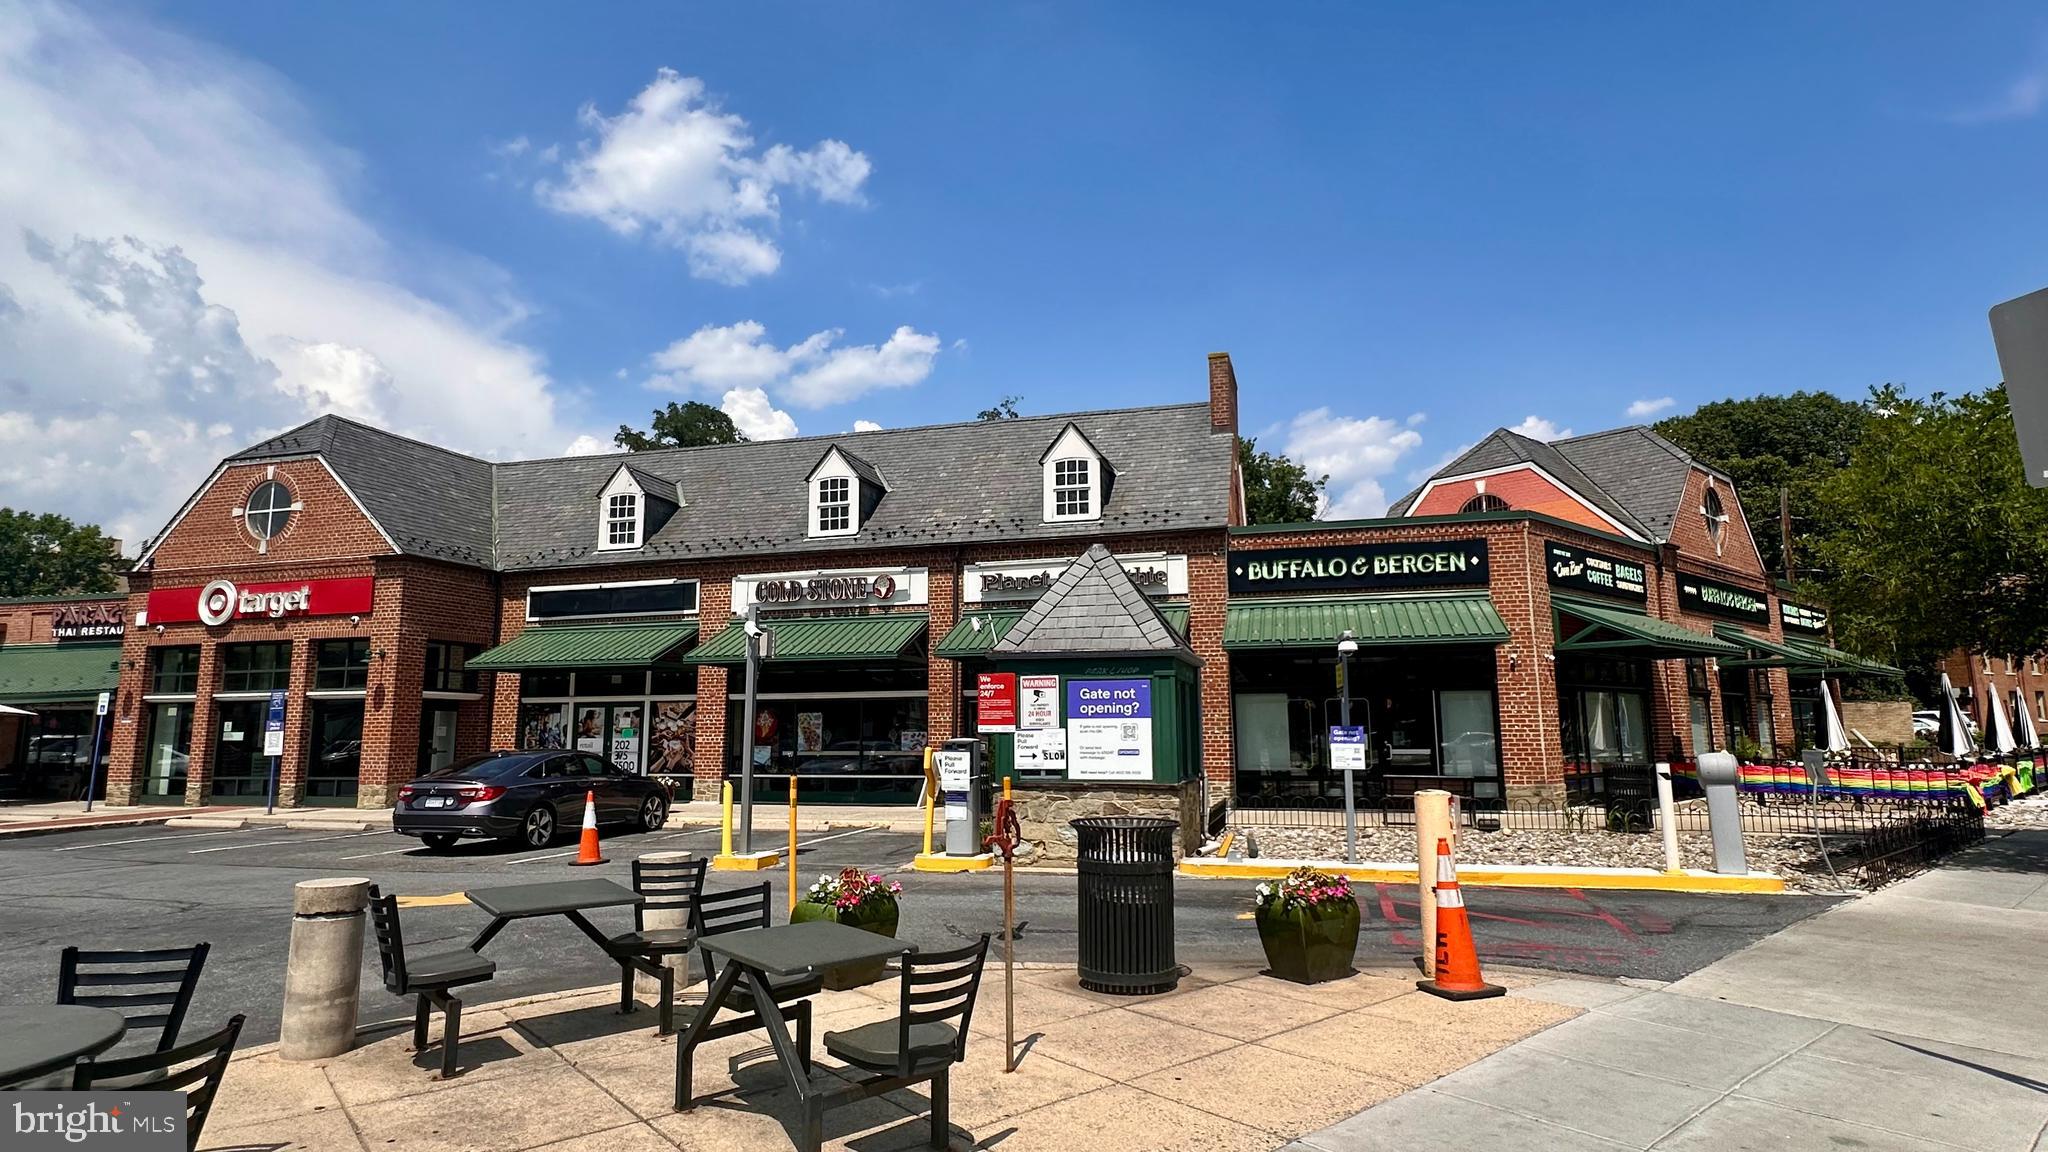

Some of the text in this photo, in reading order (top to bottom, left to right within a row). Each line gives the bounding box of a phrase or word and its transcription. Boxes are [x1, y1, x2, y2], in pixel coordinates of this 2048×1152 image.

[1248, 552, 1466, 580] BUFFALO & BERGEN
[1587, 570, 1613, 587] COFFEE
[1615, 564, 1643, 582] BAGELS
[980, 569, 1051, 592] Planet
[756, 577, 868, 602] COLD STONE
[239, 586, 310, 617] target
[51, 626, 124, 637] THAI RESTAU
[1022, 680, 1056, 688] WARNING
[980, 690, 994, 698] 24/7
[1080, 688, 1136, 699] Gate not
[1080, 702, 1140, 716] opening?
[615, 740, 630, 750] 202
[614, 750, 628, 760] 375
[1043, 752, 1065, 761] SLOW
